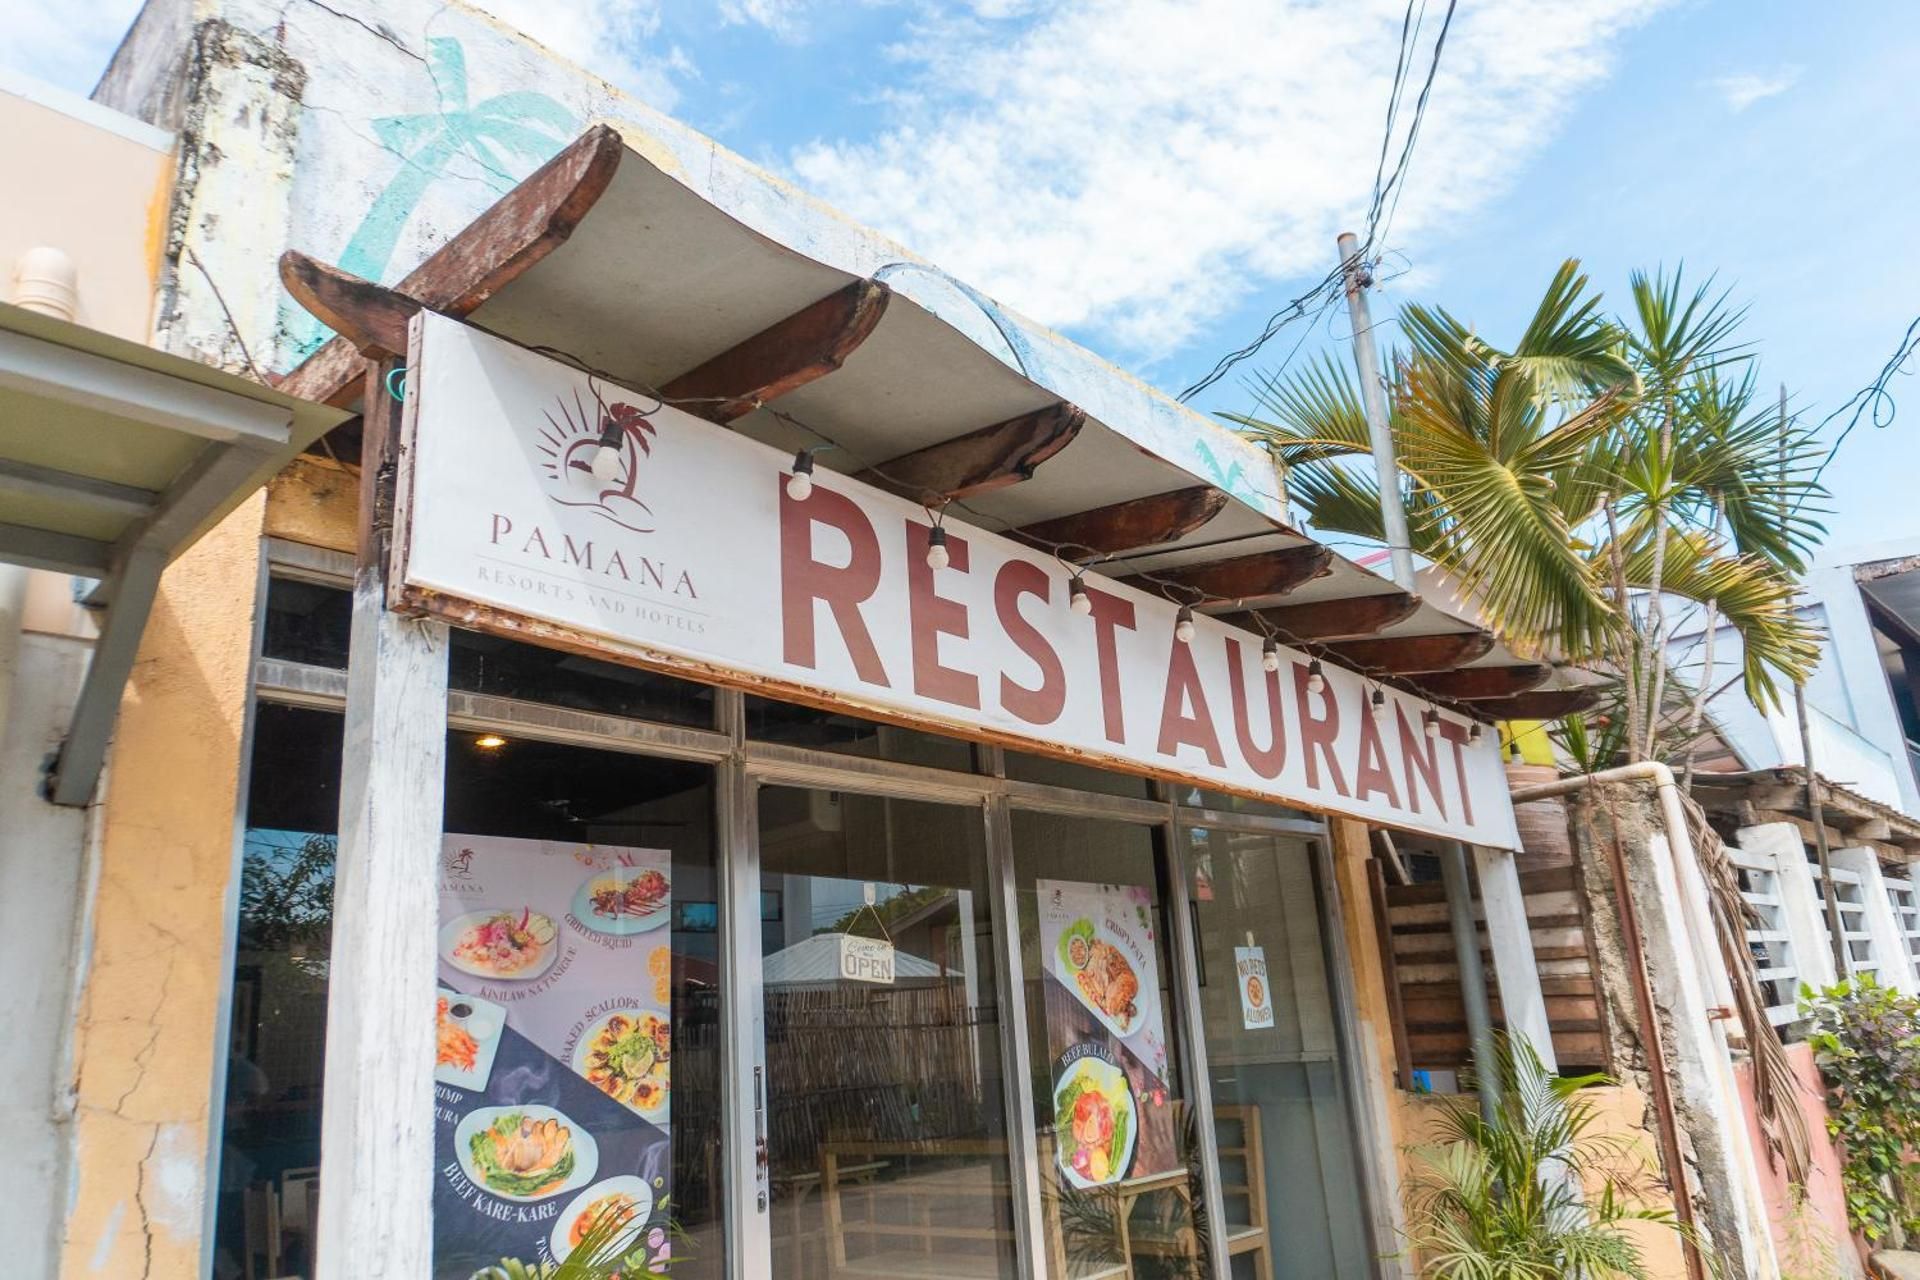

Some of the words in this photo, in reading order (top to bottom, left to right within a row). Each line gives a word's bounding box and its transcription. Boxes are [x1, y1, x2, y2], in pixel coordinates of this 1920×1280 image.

[489, 512, 699, 600] PAMANA
[477, 565, 577, 601] RESORTS
[585, 594, 626, 615] AND
[635, 606, 706, 634] HOTELS
[779, 471, 1477, 828] RESTAURANT
[439, 882, 485, 894] AMANA
[564, 912, 601, 944] GRILLED
[480, 985, 526, 1002] KINILAW
[845, 954, 891, 980] OPEN
[561, 1021, 585, 1063] BAKED
[585, 996, 639, 1022] SCALLOPS
[443, 1162, 476, 1199] BEEF
[472, 1194, 558, 1222] KARE-KARE
